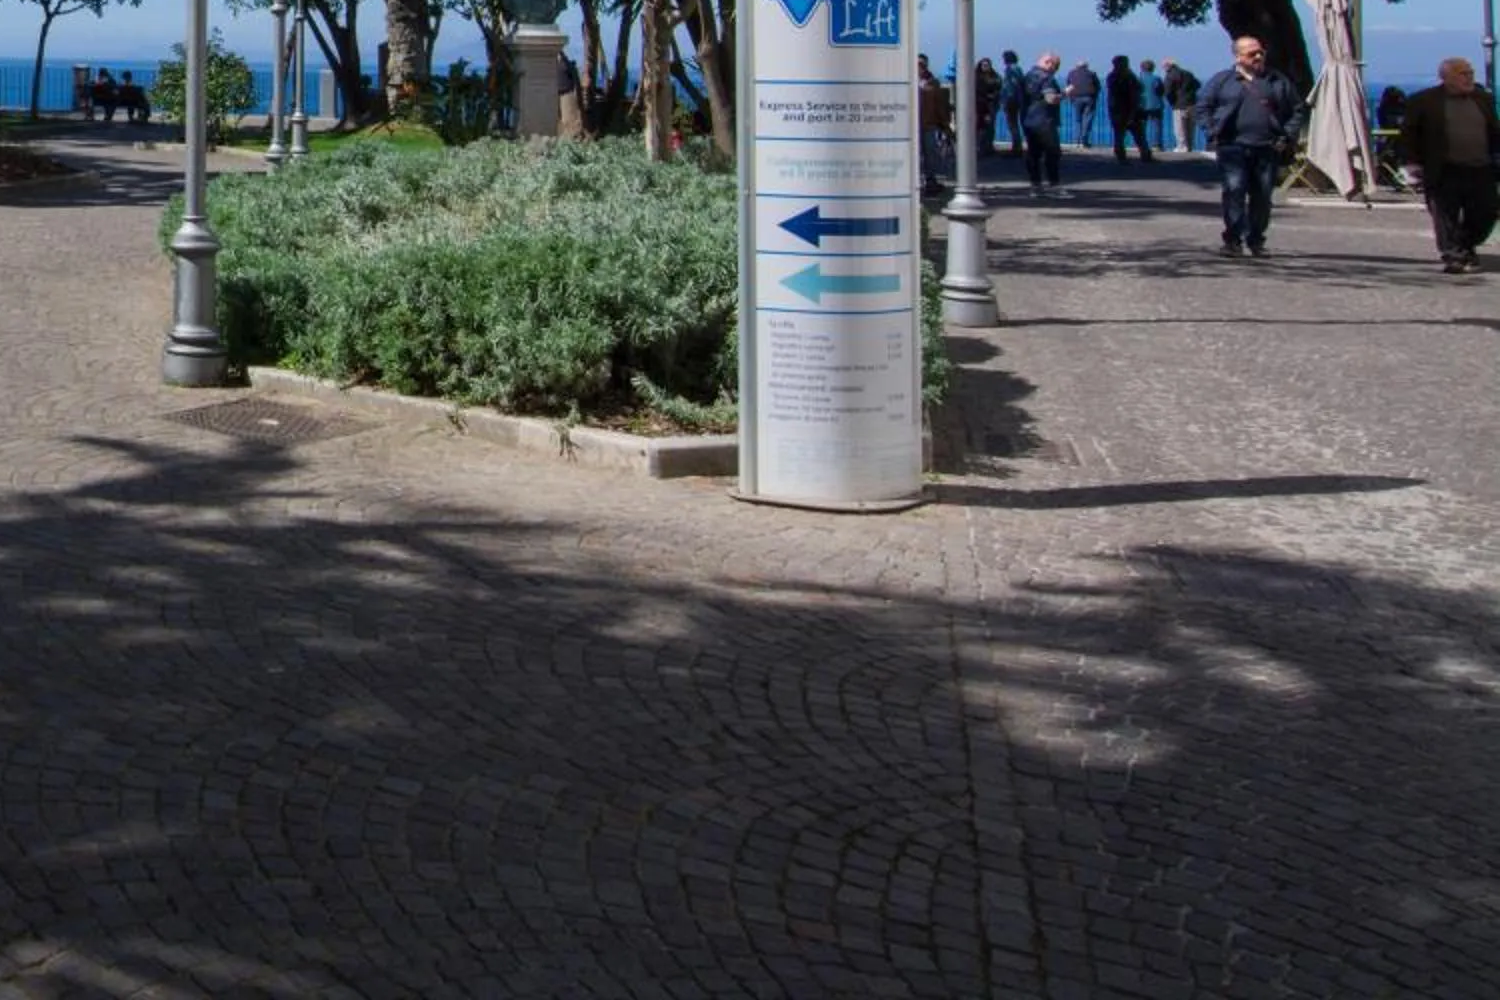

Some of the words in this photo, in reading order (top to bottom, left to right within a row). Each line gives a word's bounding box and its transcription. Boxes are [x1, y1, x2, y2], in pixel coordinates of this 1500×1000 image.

[806, 101, 847, 111] Service
[782, 113, 805, 122] and
[806, 113, 833, 124] port
